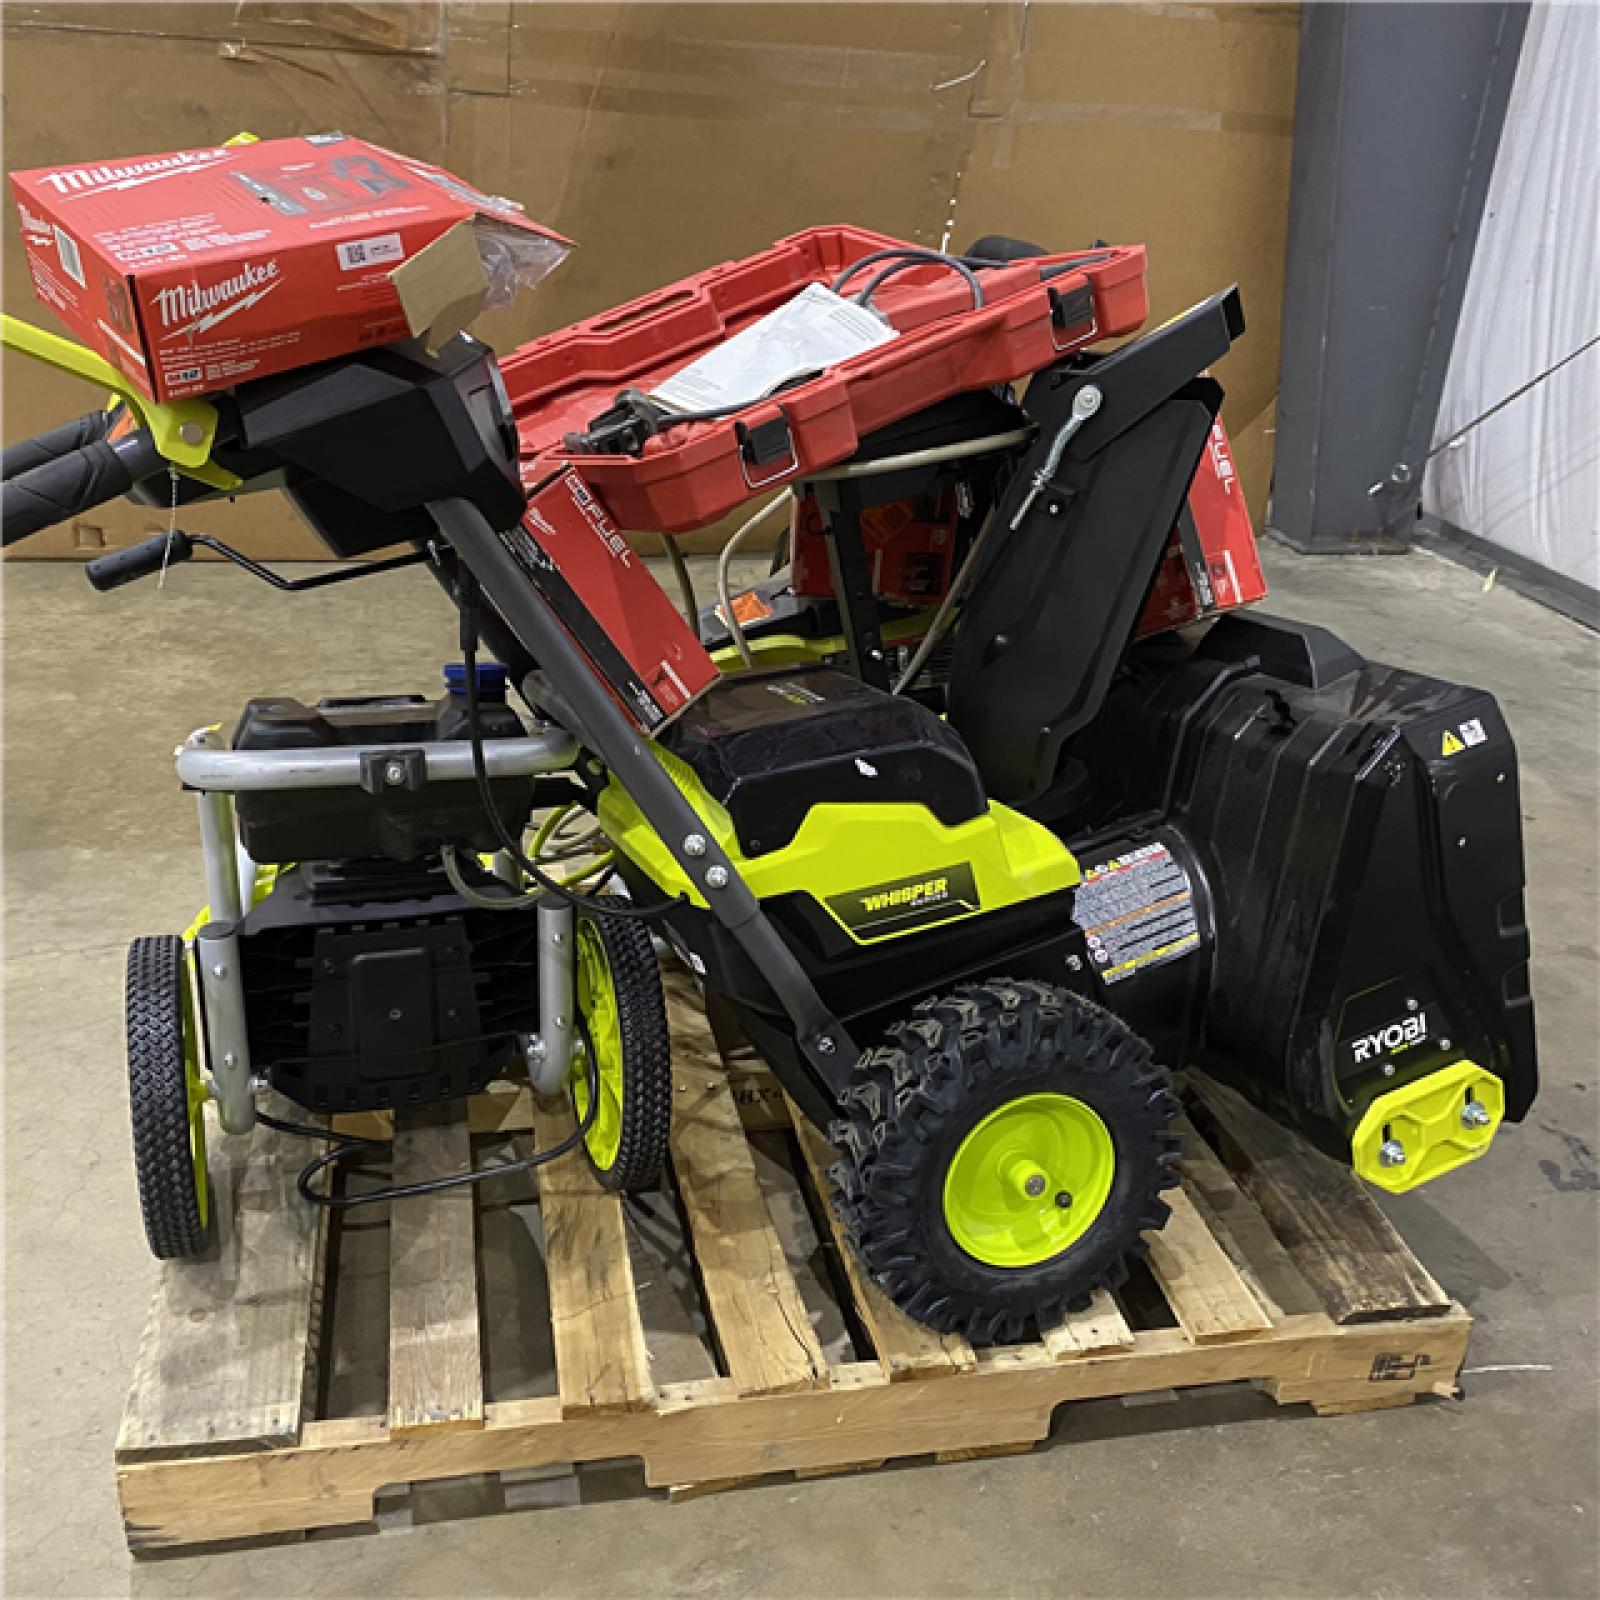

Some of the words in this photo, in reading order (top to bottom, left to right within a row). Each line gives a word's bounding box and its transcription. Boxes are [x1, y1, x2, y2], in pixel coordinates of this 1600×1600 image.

[37, 149, 228, 193] Milwaukee
[150, 258, 280, 327] Milwaukee
[860, 877, 948, 911] WHISPER
[1352, 1013, 1426, 1063] RYOBI
